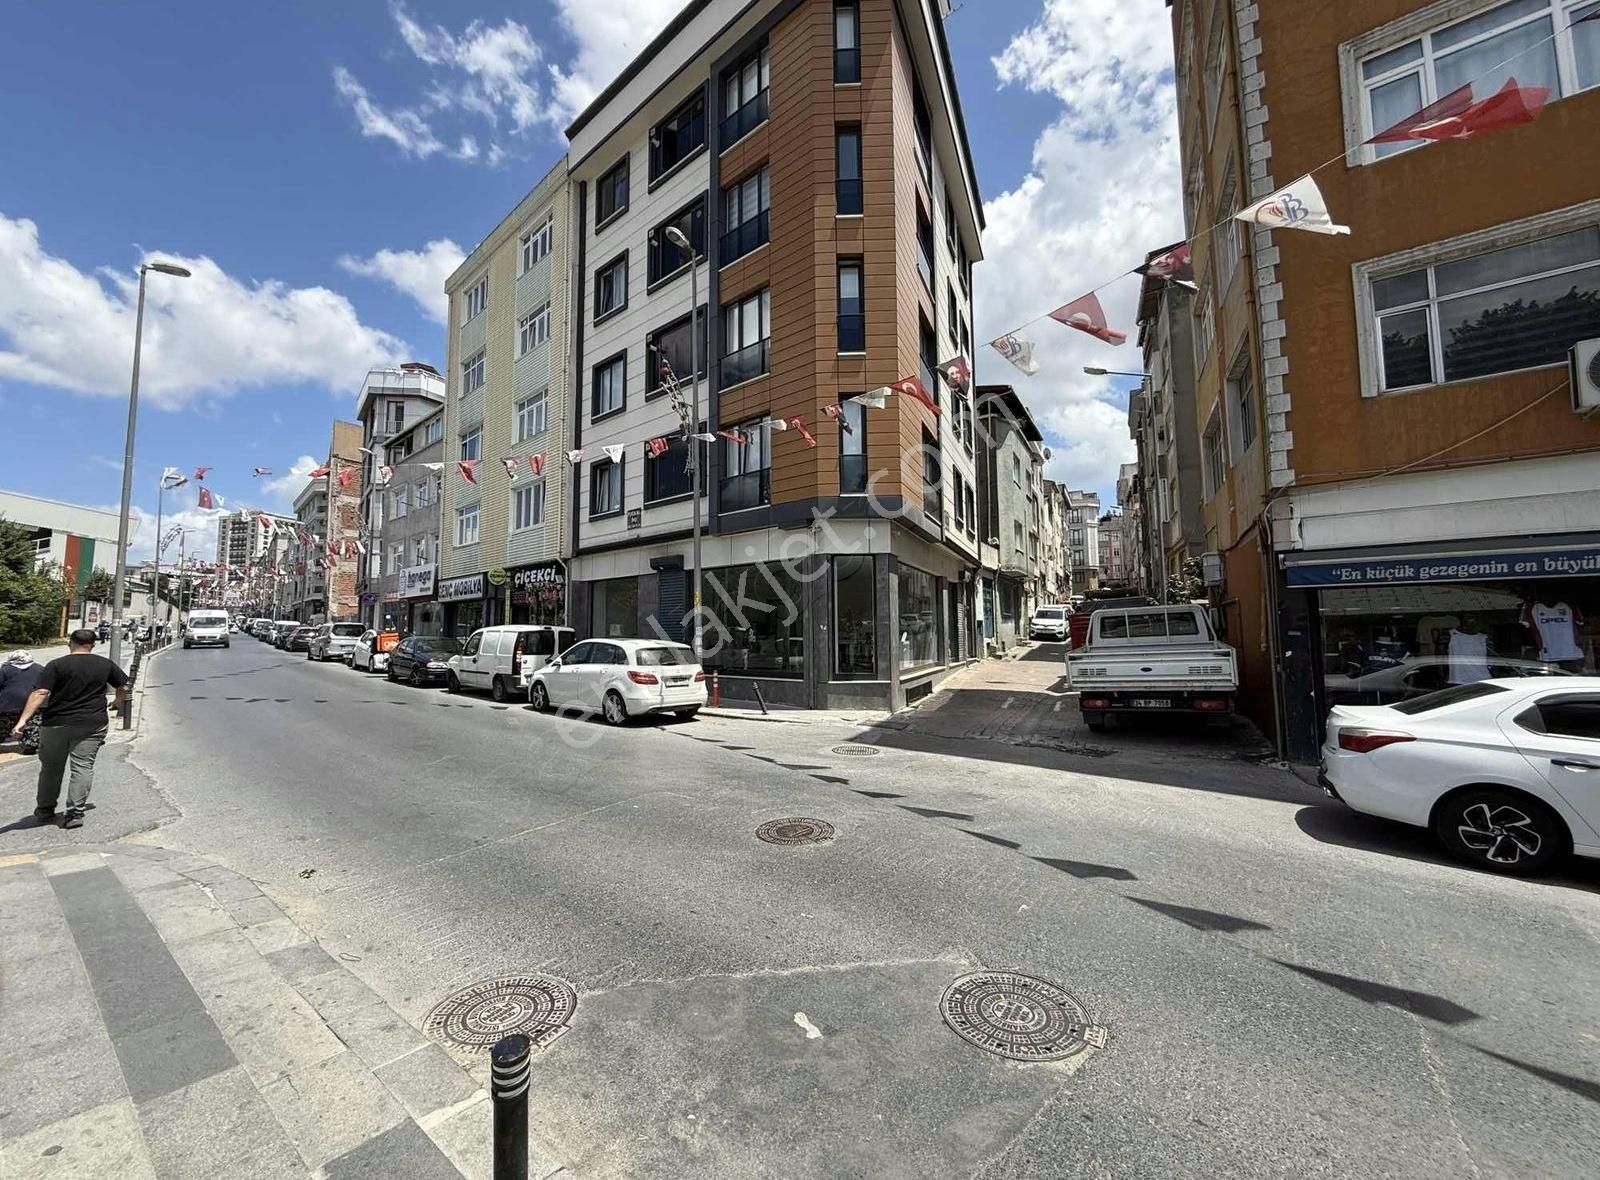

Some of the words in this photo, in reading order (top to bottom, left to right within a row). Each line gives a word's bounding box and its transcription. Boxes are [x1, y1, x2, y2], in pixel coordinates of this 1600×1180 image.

[1366, 564, 1415, 581] küçük
[1420, 560, 1508, 580] gezegenin
[1514, 561, 1538, 573] en
